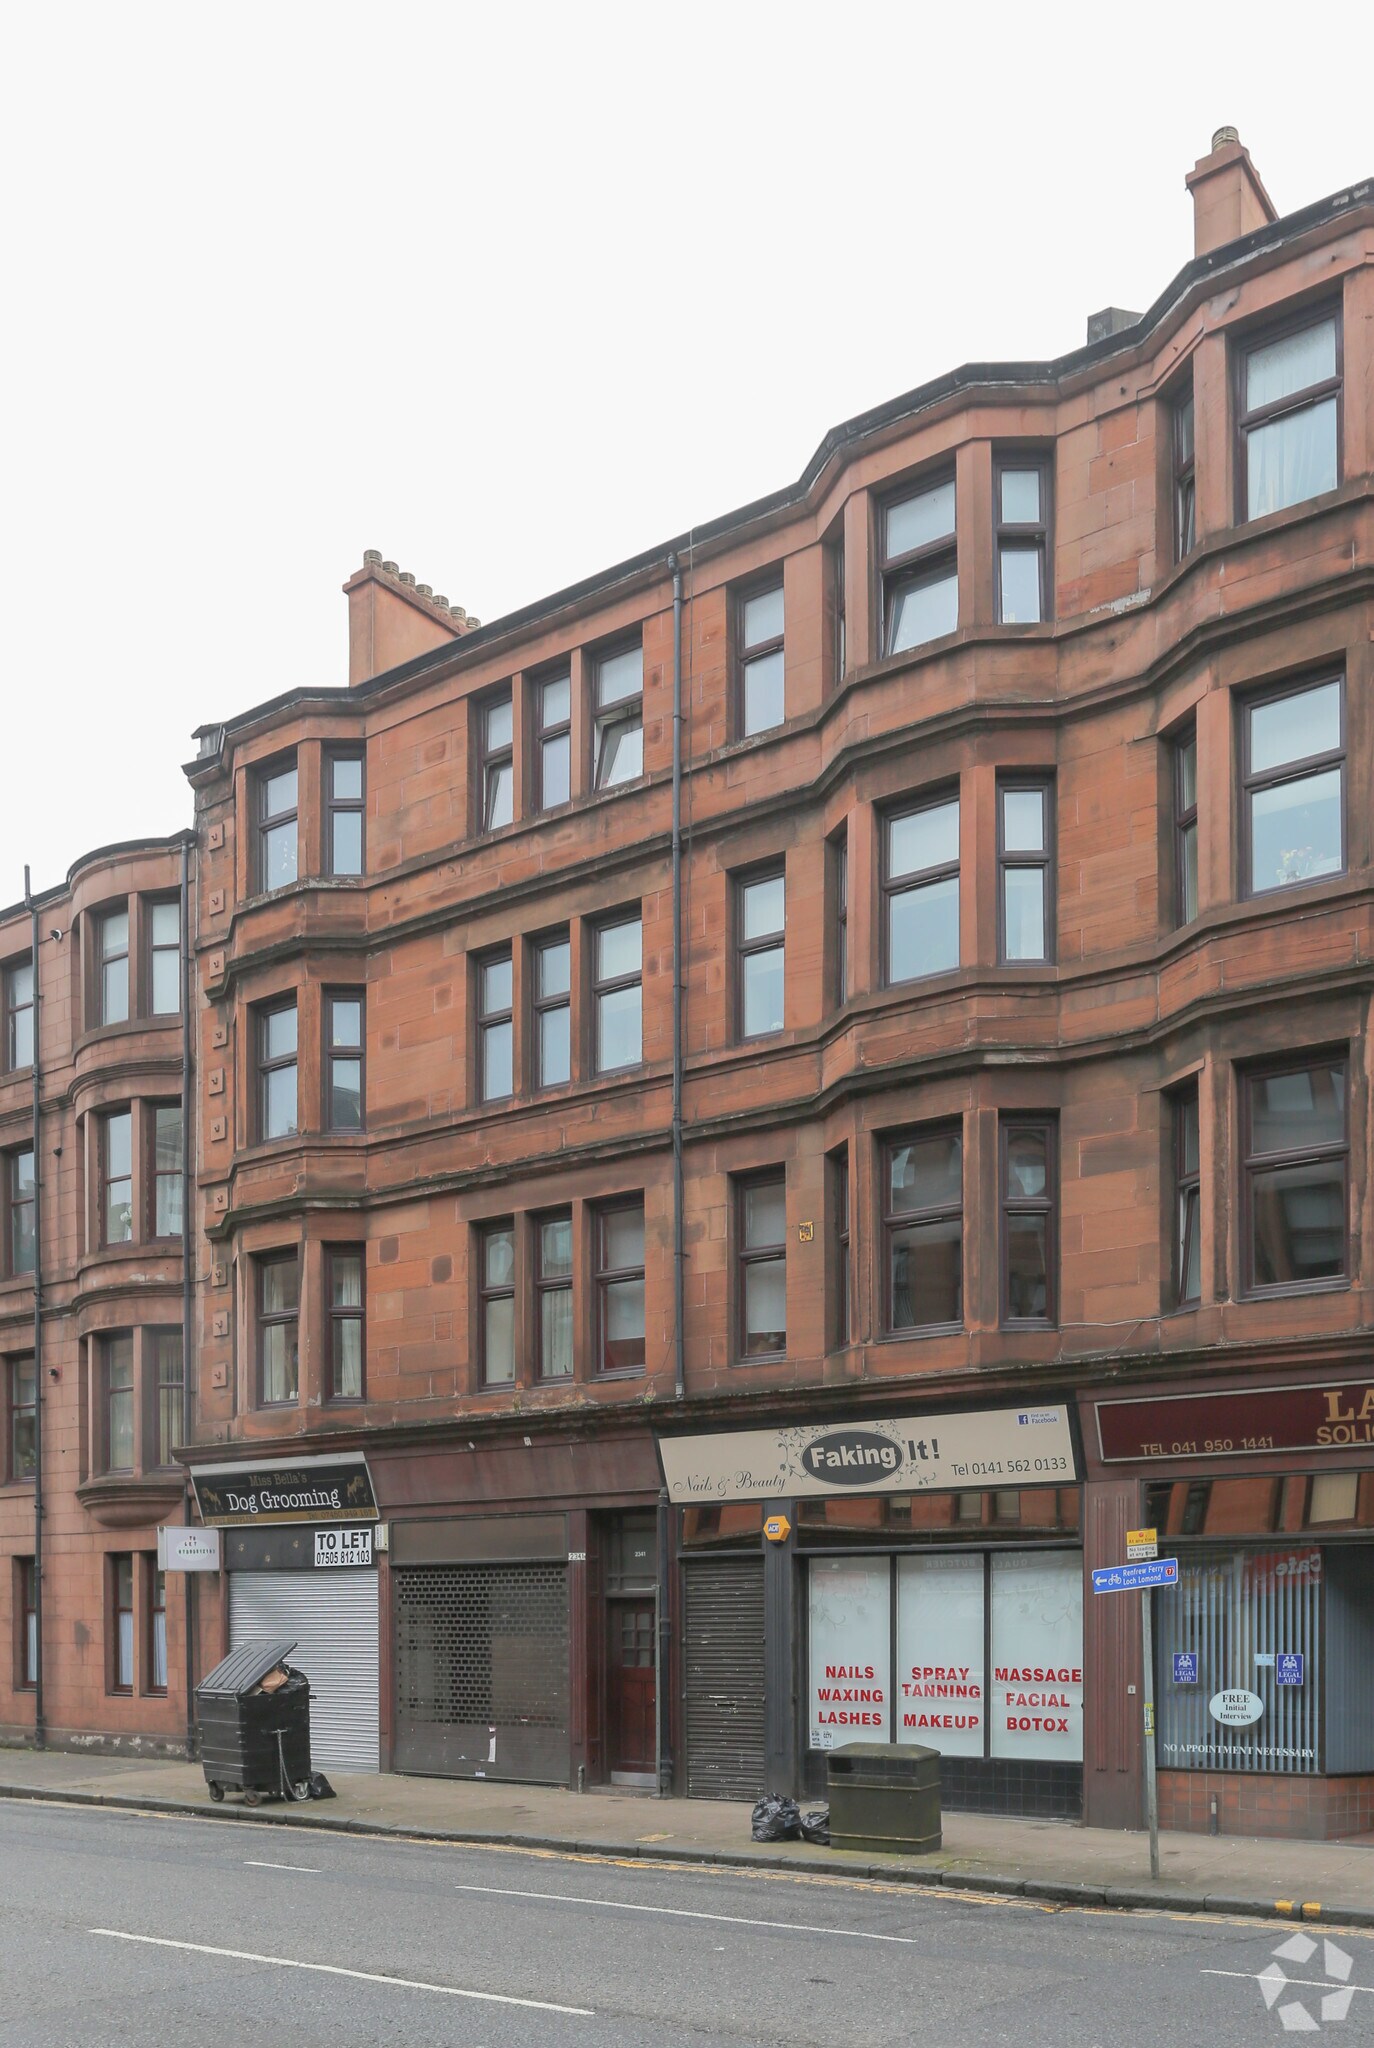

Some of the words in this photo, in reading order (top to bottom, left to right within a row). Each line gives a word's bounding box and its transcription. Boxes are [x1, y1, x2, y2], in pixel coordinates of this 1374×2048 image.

[1316, 1424, 1374, 1445] SOLI
[1140, 1444, 1168, 1456] TEL
[1172, 1442, 1197, 1454] 041
[1204, 1439, 1233, 1452] 950
[1240, 1437, 1274, 1450] 1441
[810, 1444, 896, 1469] Faking
[951, 1464, 969, 1476] Tel
[972, 1461, 1003, 1475] 0141
[1007, 1460, 1031, 1472] 562
[1034, 1457, 1067, 1471] 0133
[248, 1475, 271, 1487] Miss
[275, 1473, 308, 1485] Bella's
[673, 1475, 712, 1492] Nails
[734, 1470, 786, 1493] Beauty
[226, 1494, 258, 1514] Dog
[260, 1489, 341, 1509] Grooming
[317, 1533, 336, 1550] TO
[342, 1532, 369, 1549] LET
[316, 1552, 338, 1564] 07505
[341, 1551, 354, 1563] 812
[357, 1550, 370, 1562] 103
[1123, 1568, 1146, 1576] Renfrew
[1148, 1565, 1164, 1573] Ferry
[1123, 1577, 1136, 1586] Loch
[1138, 1574, 1161, 1584] Lomond
[826, 1666, 874, 1679] NAILS
[912, 1667, 970, 1680] SPRAY
[995, 1668, 1082, 1683] MASSAGE
[818, 1689, 884, 1702] WAXING
[902, 1684, 981, 1698] TANNING
[1222, 1694, 1250, 1703] FREE
[1006, 1692, 1070, 1708] FACIAL
[818, 1711, 882, 1726] LASHES
[904, 1714, 979, 1729] MAKEUP
[1006, 1717, 1068, 1732] BOTOX
[1179, 1744, 1253, 1755] APPOINTMENT
[1256, 1747, 1315, 1758] NECESSARY
